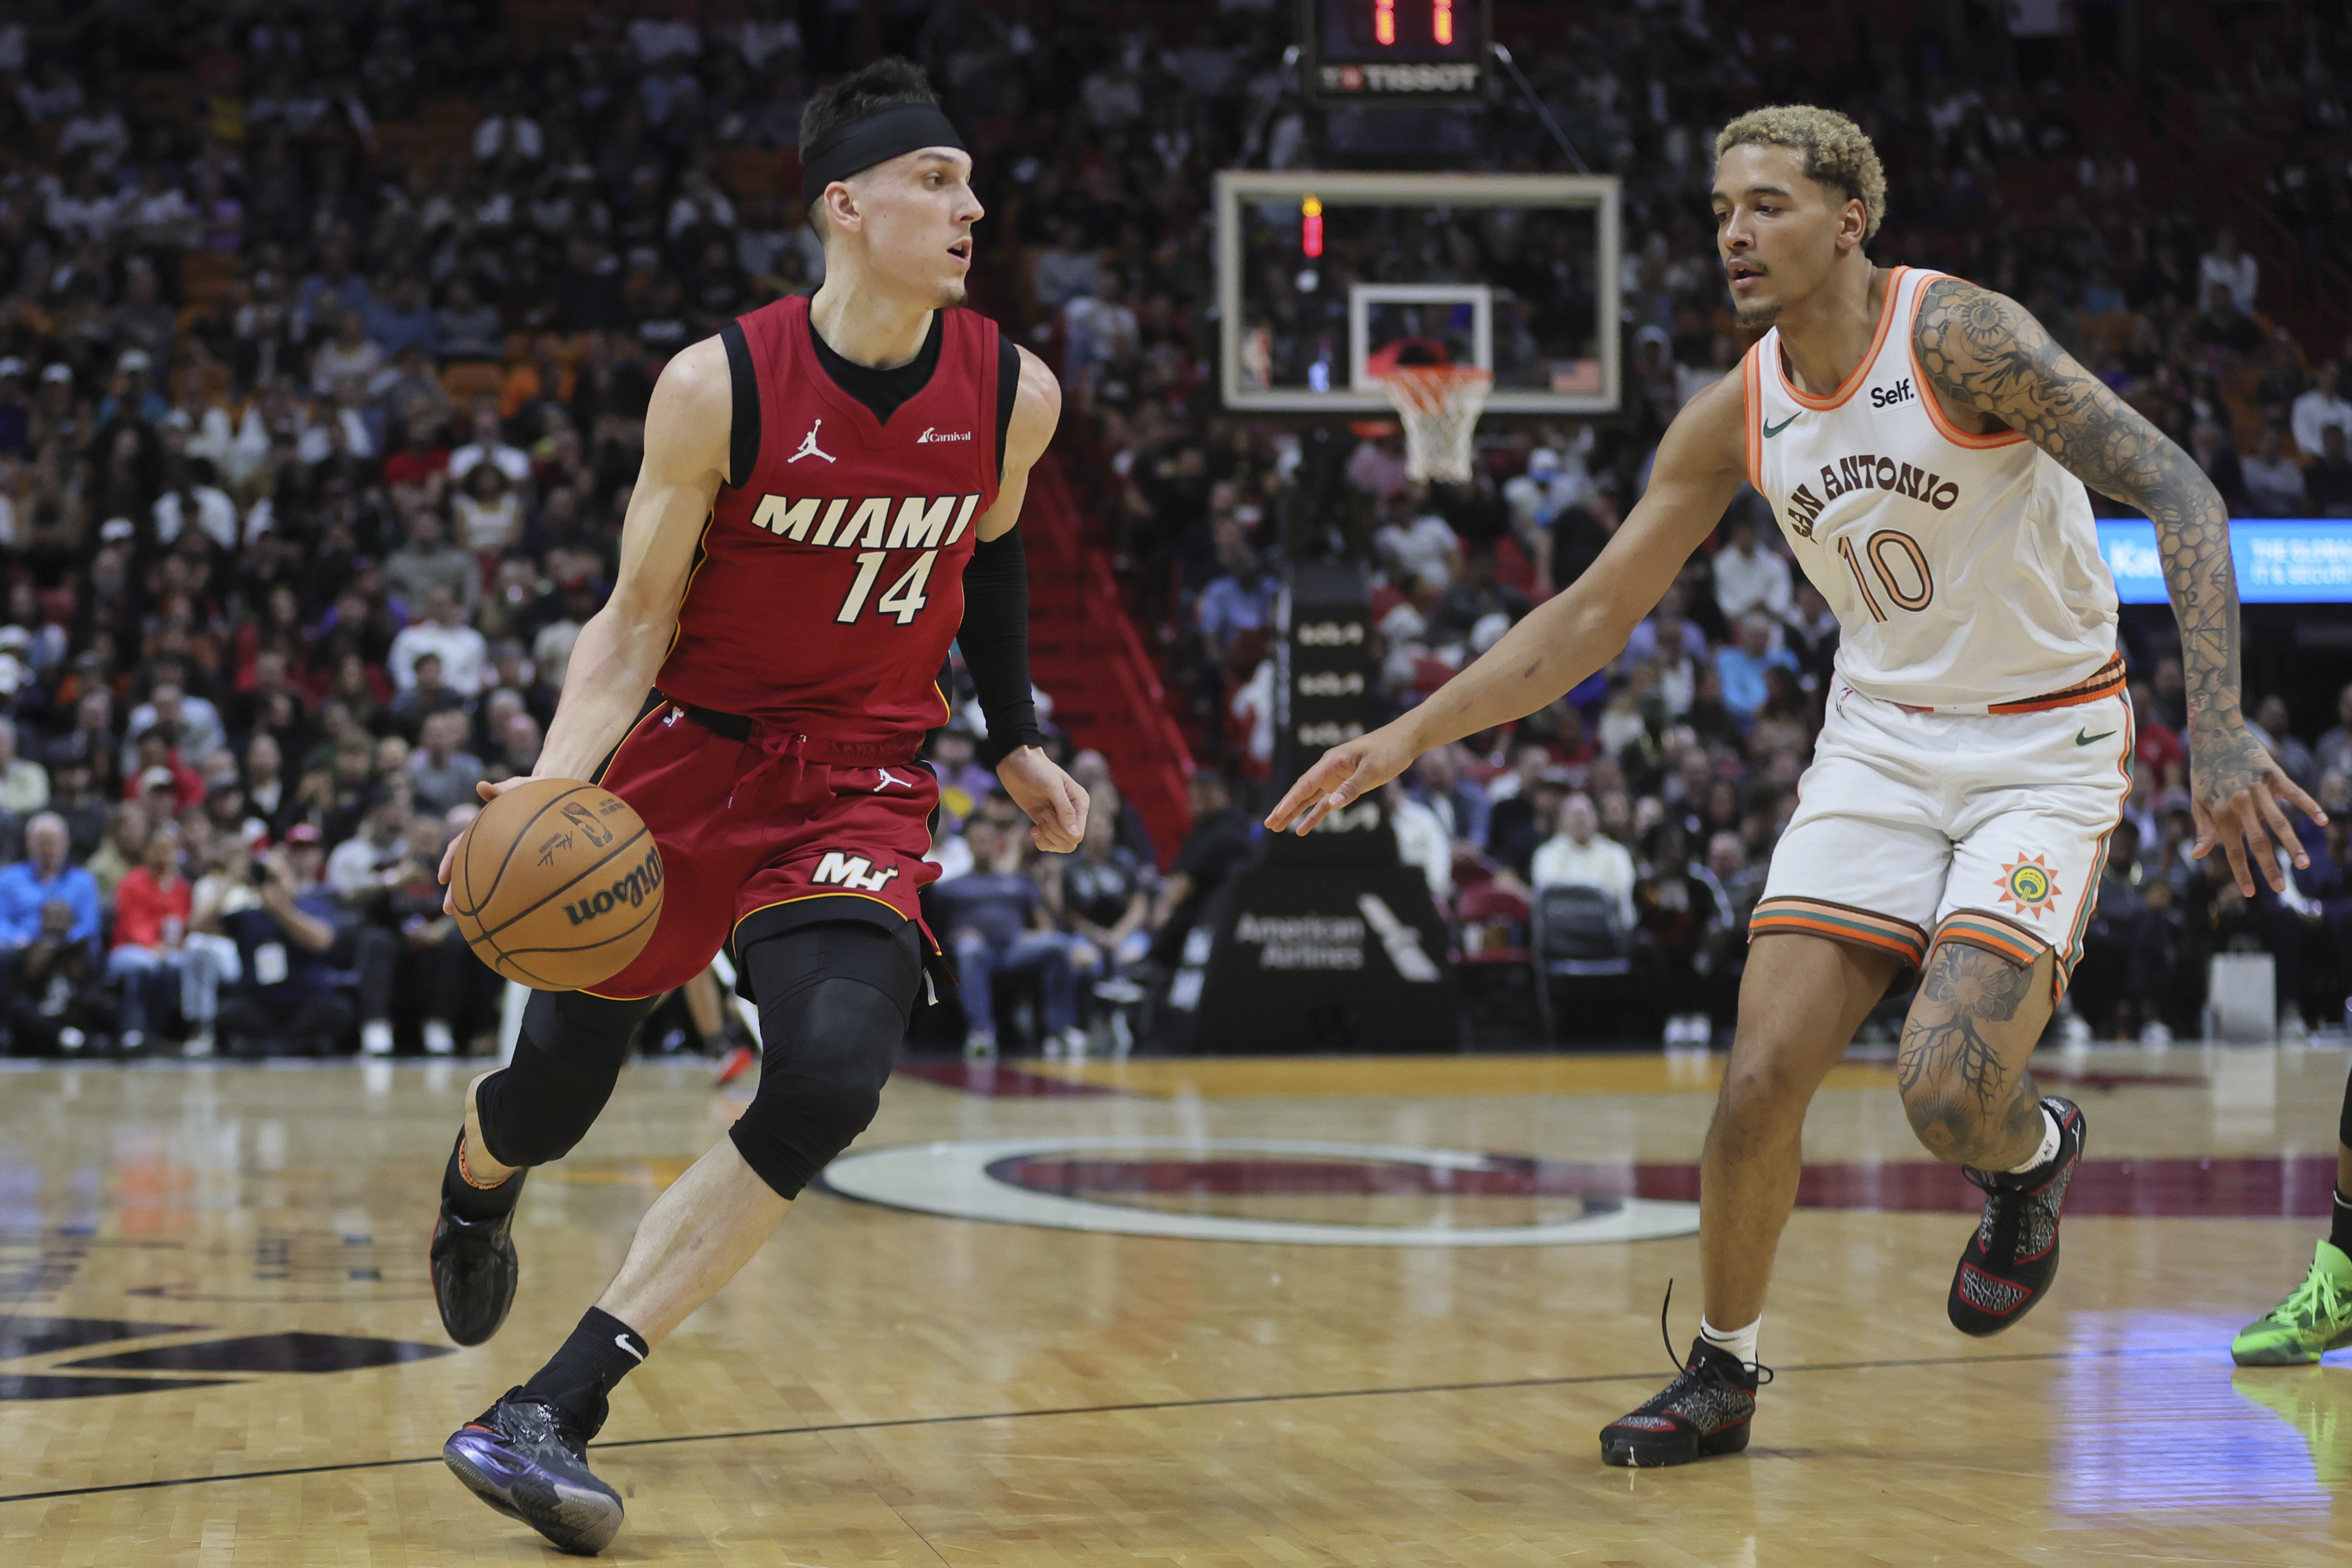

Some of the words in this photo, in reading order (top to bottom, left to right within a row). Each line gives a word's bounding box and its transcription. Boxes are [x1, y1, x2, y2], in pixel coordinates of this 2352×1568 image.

[1364, 64, 1480, 91] TISSOT
[1871, 378, 1914, 408] Self.
[930, 431, 971, 442] Carnival
[1820, 455, 1959, 510] ANTONIO
[751, 493, 982, 549] MIAMI
[833, 549, 939, 626] 14
[1838, 529, 1934, 623] 10
[562, 845, 663, 926] Wilson
